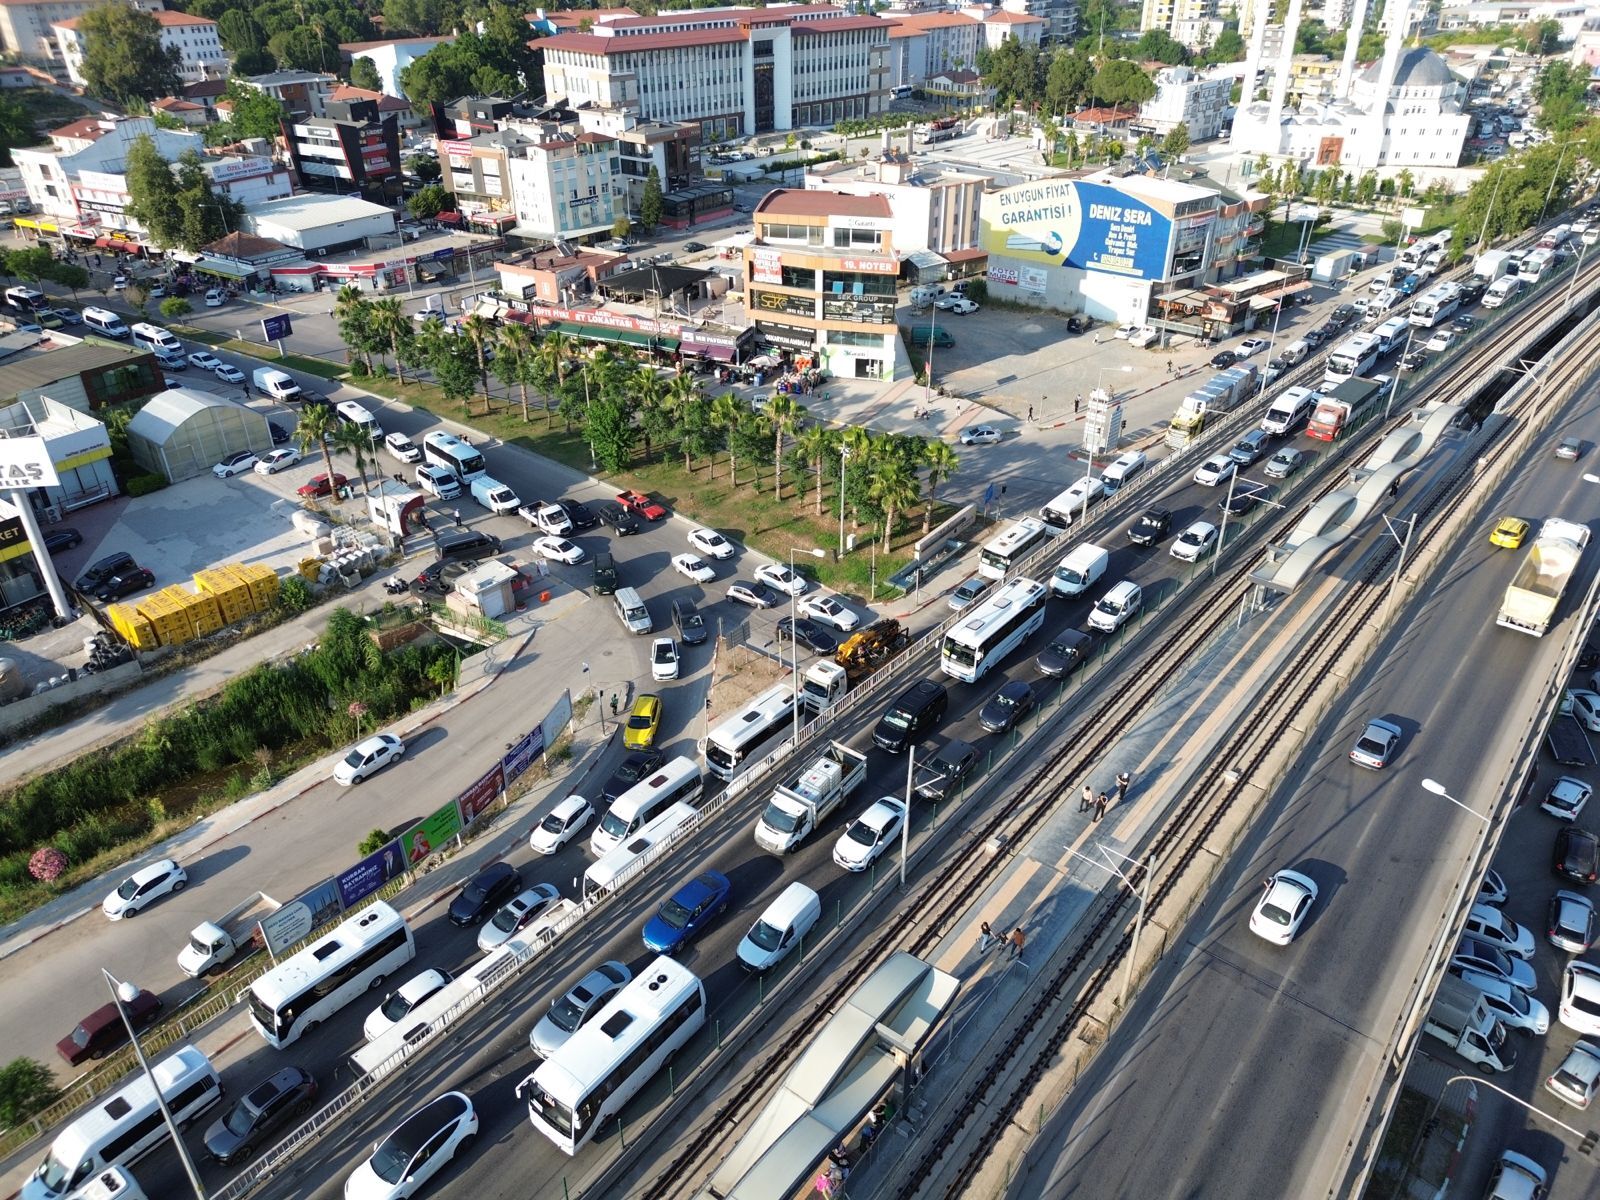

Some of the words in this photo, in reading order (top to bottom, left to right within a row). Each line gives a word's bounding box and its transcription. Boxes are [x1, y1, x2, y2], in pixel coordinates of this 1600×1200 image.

[1000, 193, 1012, 206] EN
[1013, 188, 1044, 204] UYGUN
[1046, 183, 1070, 199] FİYAT
[1002, 203, 1066, 224] GARANTİSİ
[1123, 208, 1152, 226] SERA
[844, 261, 857, 270] 19.
[859, 261, 892, 271] NOTER
[992, 267, 1015, 276] FOTO
[990, 272, 1017, 280] MURAT
[854, 295, 879, 303] GROUP
[342, 866, 366, 883] KURBAN
[343, 864, 378, 889] BAYRAMINIZ
